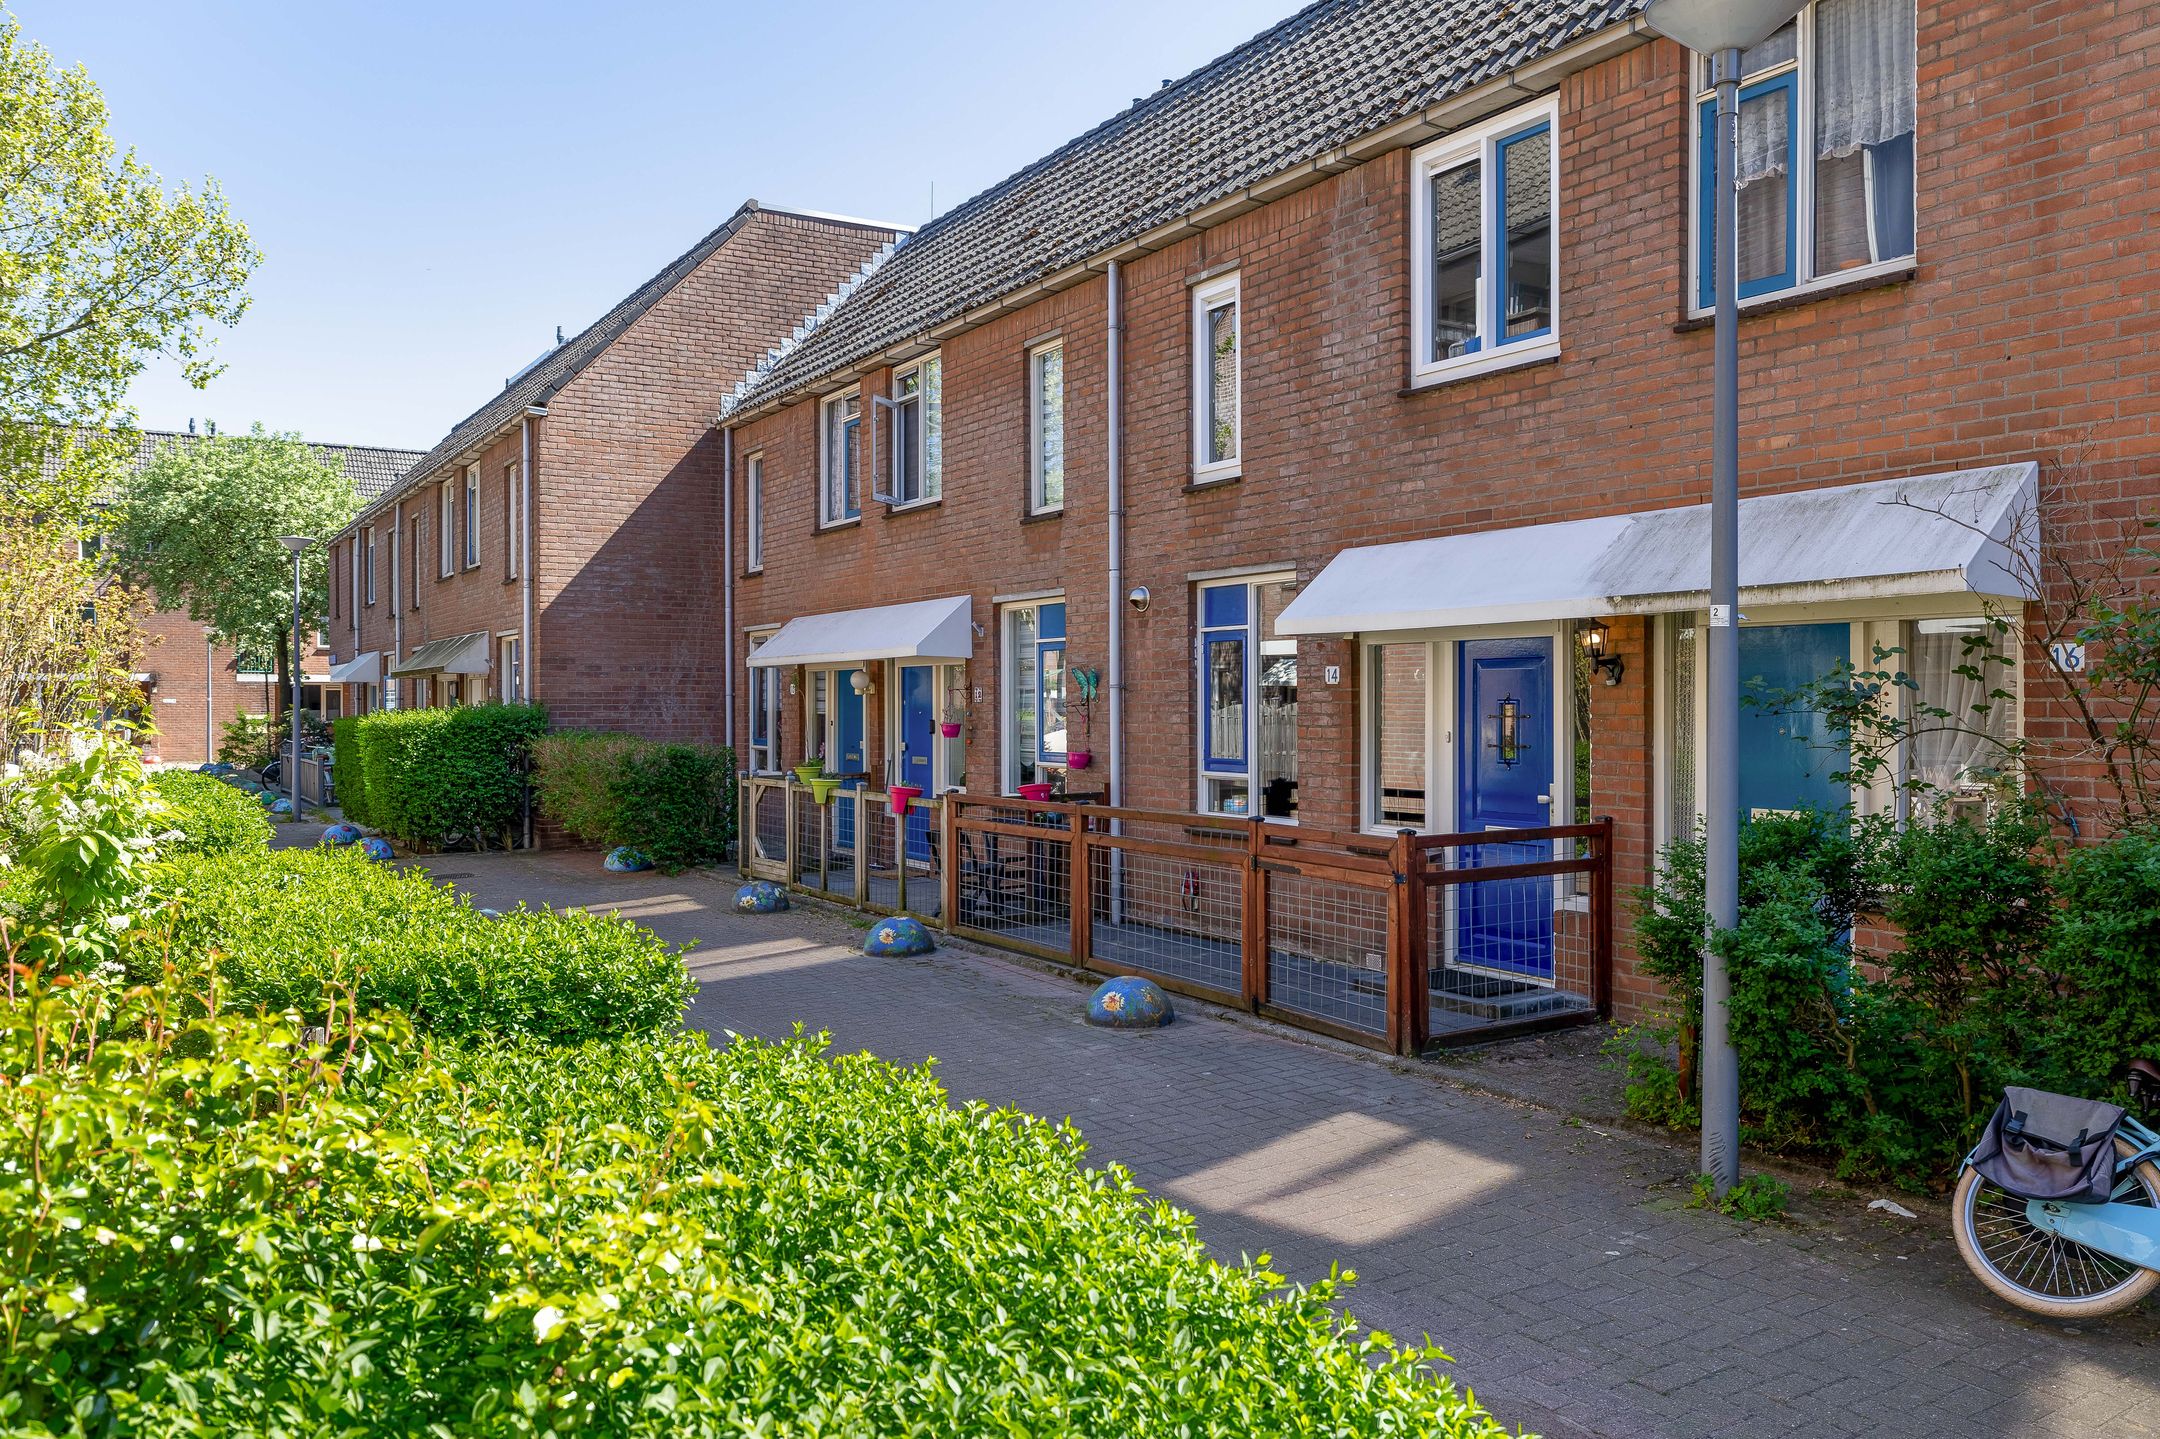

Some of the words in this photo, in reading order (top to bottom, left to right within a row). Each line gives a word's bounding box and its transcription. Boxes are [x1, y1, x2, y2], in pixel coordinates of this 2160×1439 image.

[1713, 607, 1719, 616] 2
[2053, 647, 2080, 668] 16
[1326, 668, 1338, 682] 14
